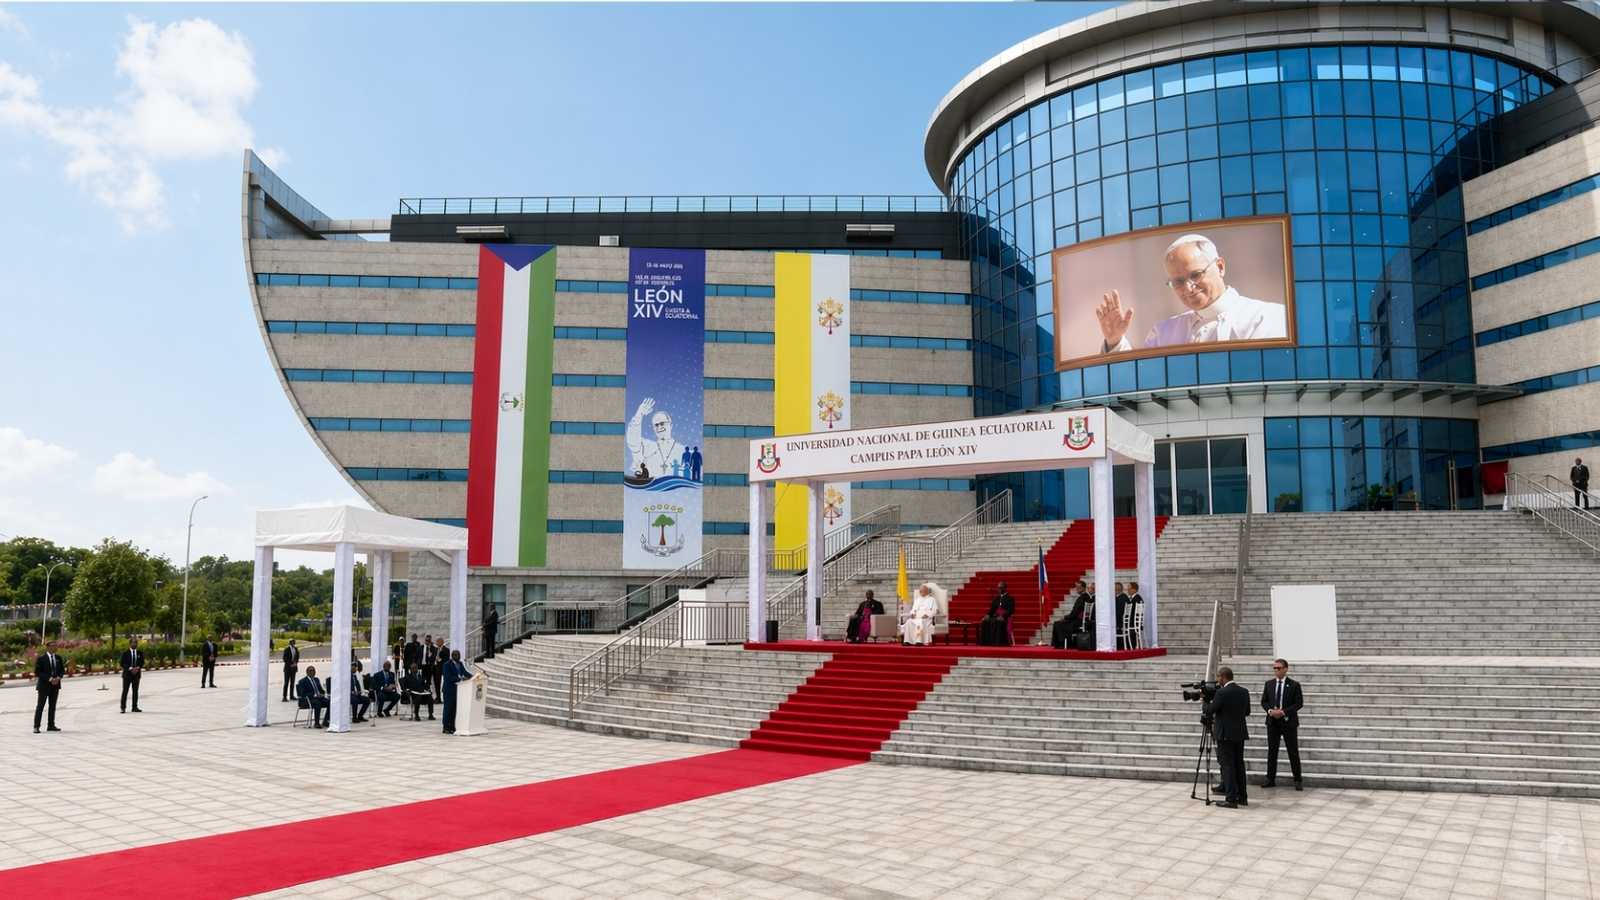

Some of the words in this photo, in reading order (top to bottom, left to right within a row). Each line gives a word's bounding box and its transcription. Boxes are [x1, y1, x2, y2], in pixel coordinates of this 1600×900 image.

[634, 285, 683, 304] LEÓN
[633, 304, 664, 318] XIV
[786, 438, 854, 452] UNIVERSIDAD
[857, 432, 913, 445] NACIONAL
[916, 430, 931, 441] DE
[932, 427, 976, 440] GUINEA
[980, 420, 1055, 436] ECUATORIAL
[850, 450, 895, 464] CAMPUS
[898, 449, 923, 461] PAPA
[926, 444, 955, 458] LEÓN
[958, 445, 978, 456] XIV
